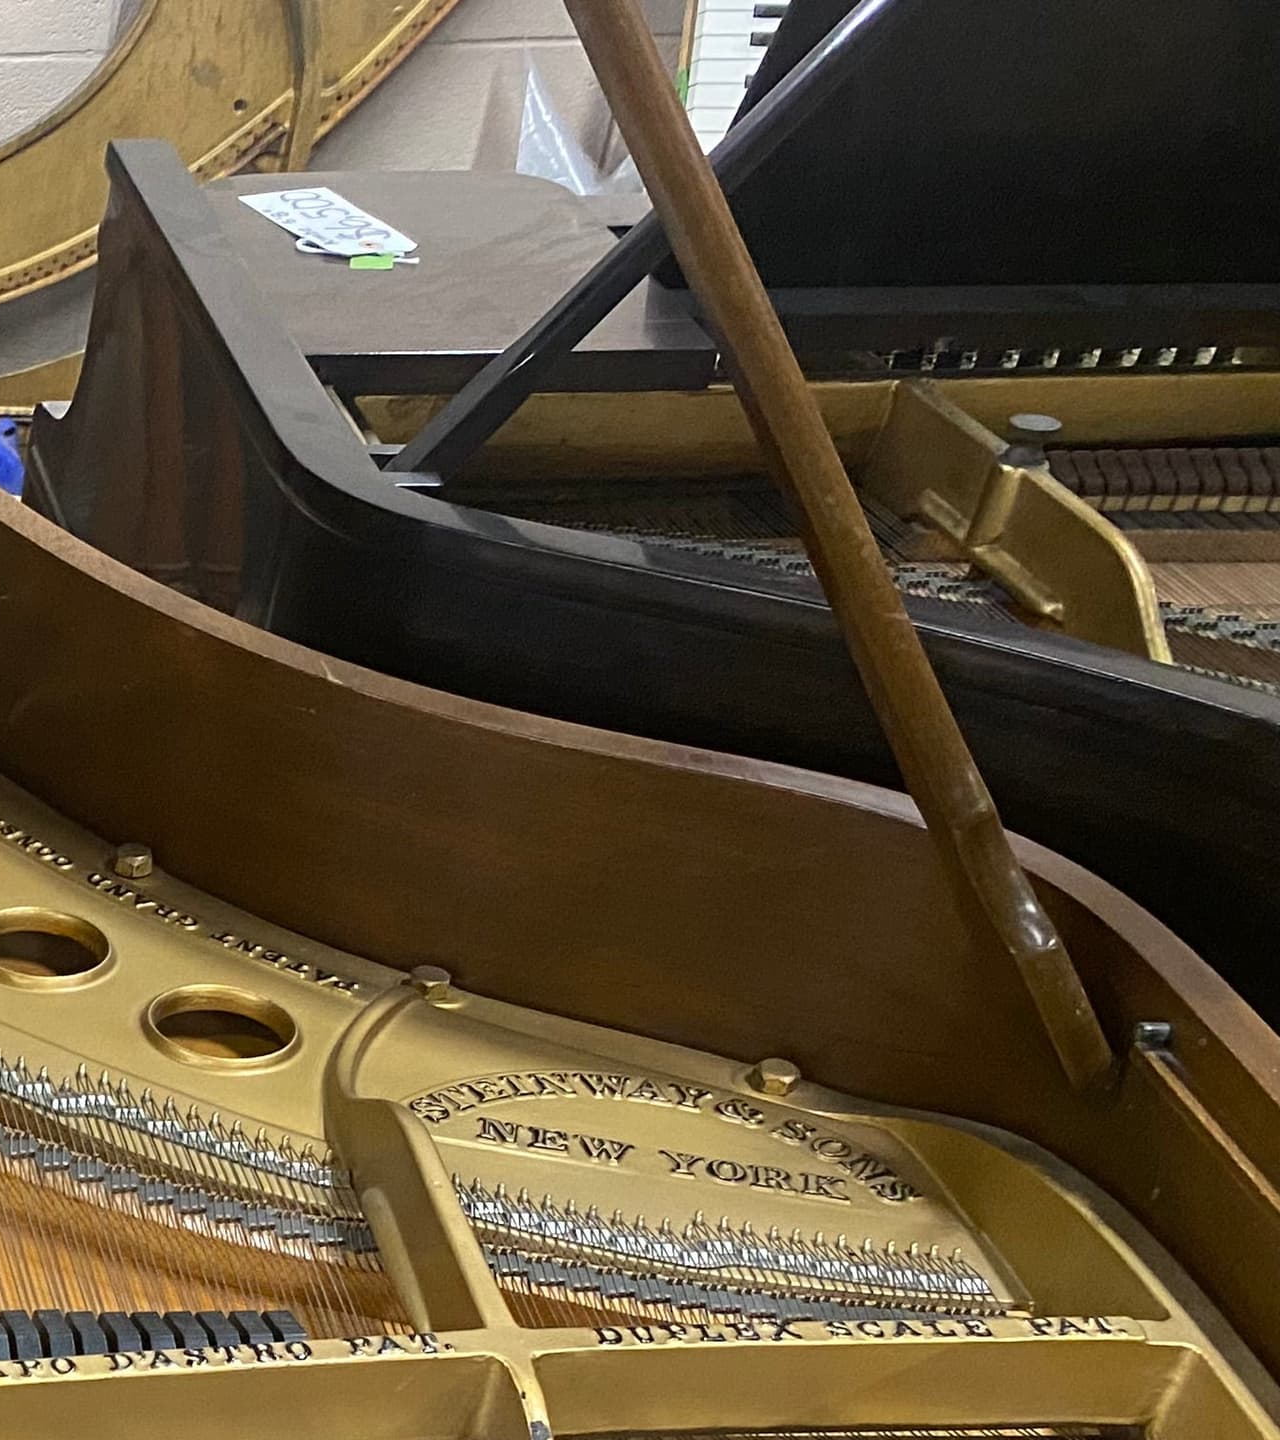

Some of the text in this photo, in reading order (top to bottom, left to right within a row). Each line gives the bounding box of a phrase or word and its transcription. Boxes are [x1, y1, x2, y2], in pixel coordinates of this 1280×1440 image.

[88, 871, 199, 931] GRAND
[210, 932, 359, 996] PATENT
[409, 1071, 924, 1204] STEINWAY & SONS
[475, 1116, 853, 1206] NEW YORK
[105, 1340, 313, 1372] D'ASTRO
[343, 1332, 454, 1356] PAT.
[593, 1319, 803, 1345] DUPLEX
[825, 1318, 994, 1338] SCALE
